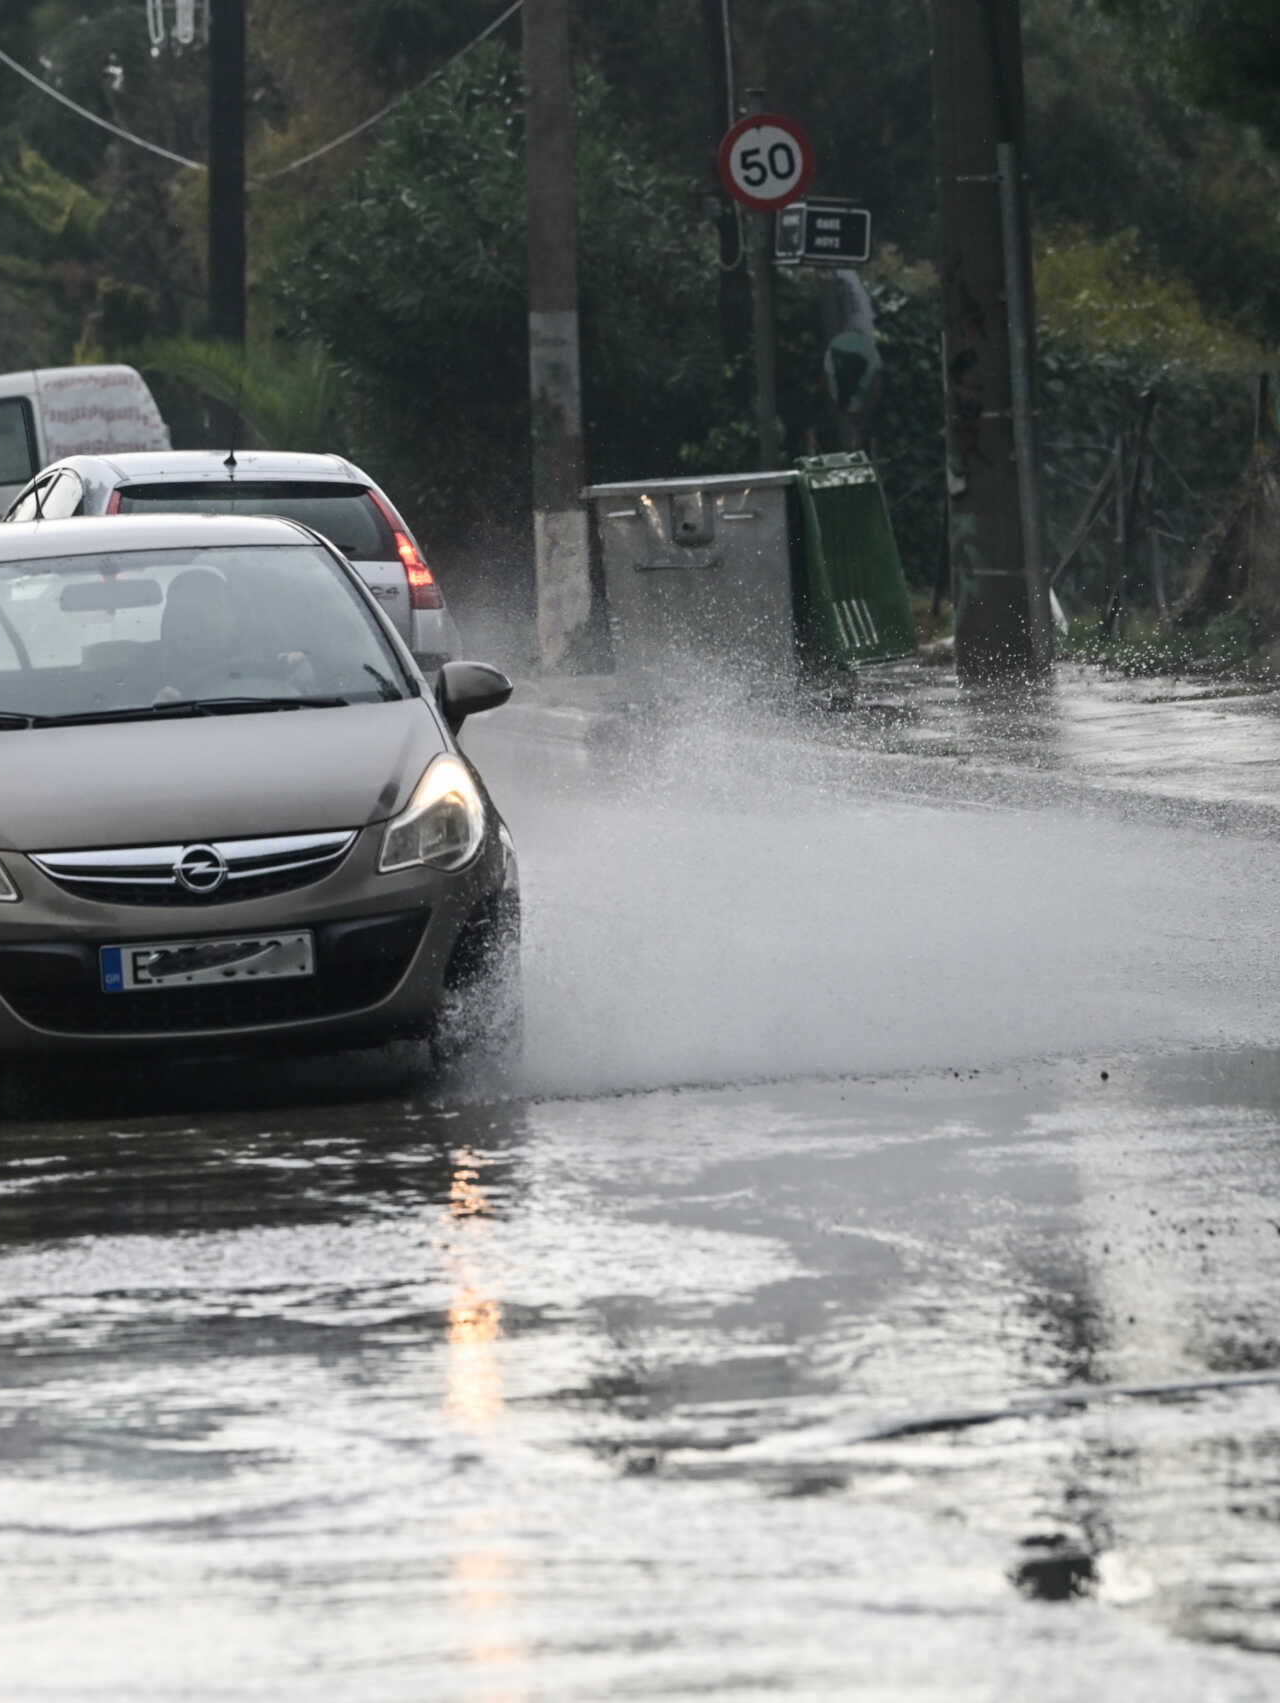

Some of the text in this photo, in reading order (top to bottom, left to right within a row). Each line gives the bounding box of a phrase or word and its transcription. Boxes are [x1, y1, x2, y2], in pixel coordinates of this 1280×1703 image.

[741, 142, 795, 187] 50
[369, 585, 400, 598] C4
[105, 973, 120, 984] GR
